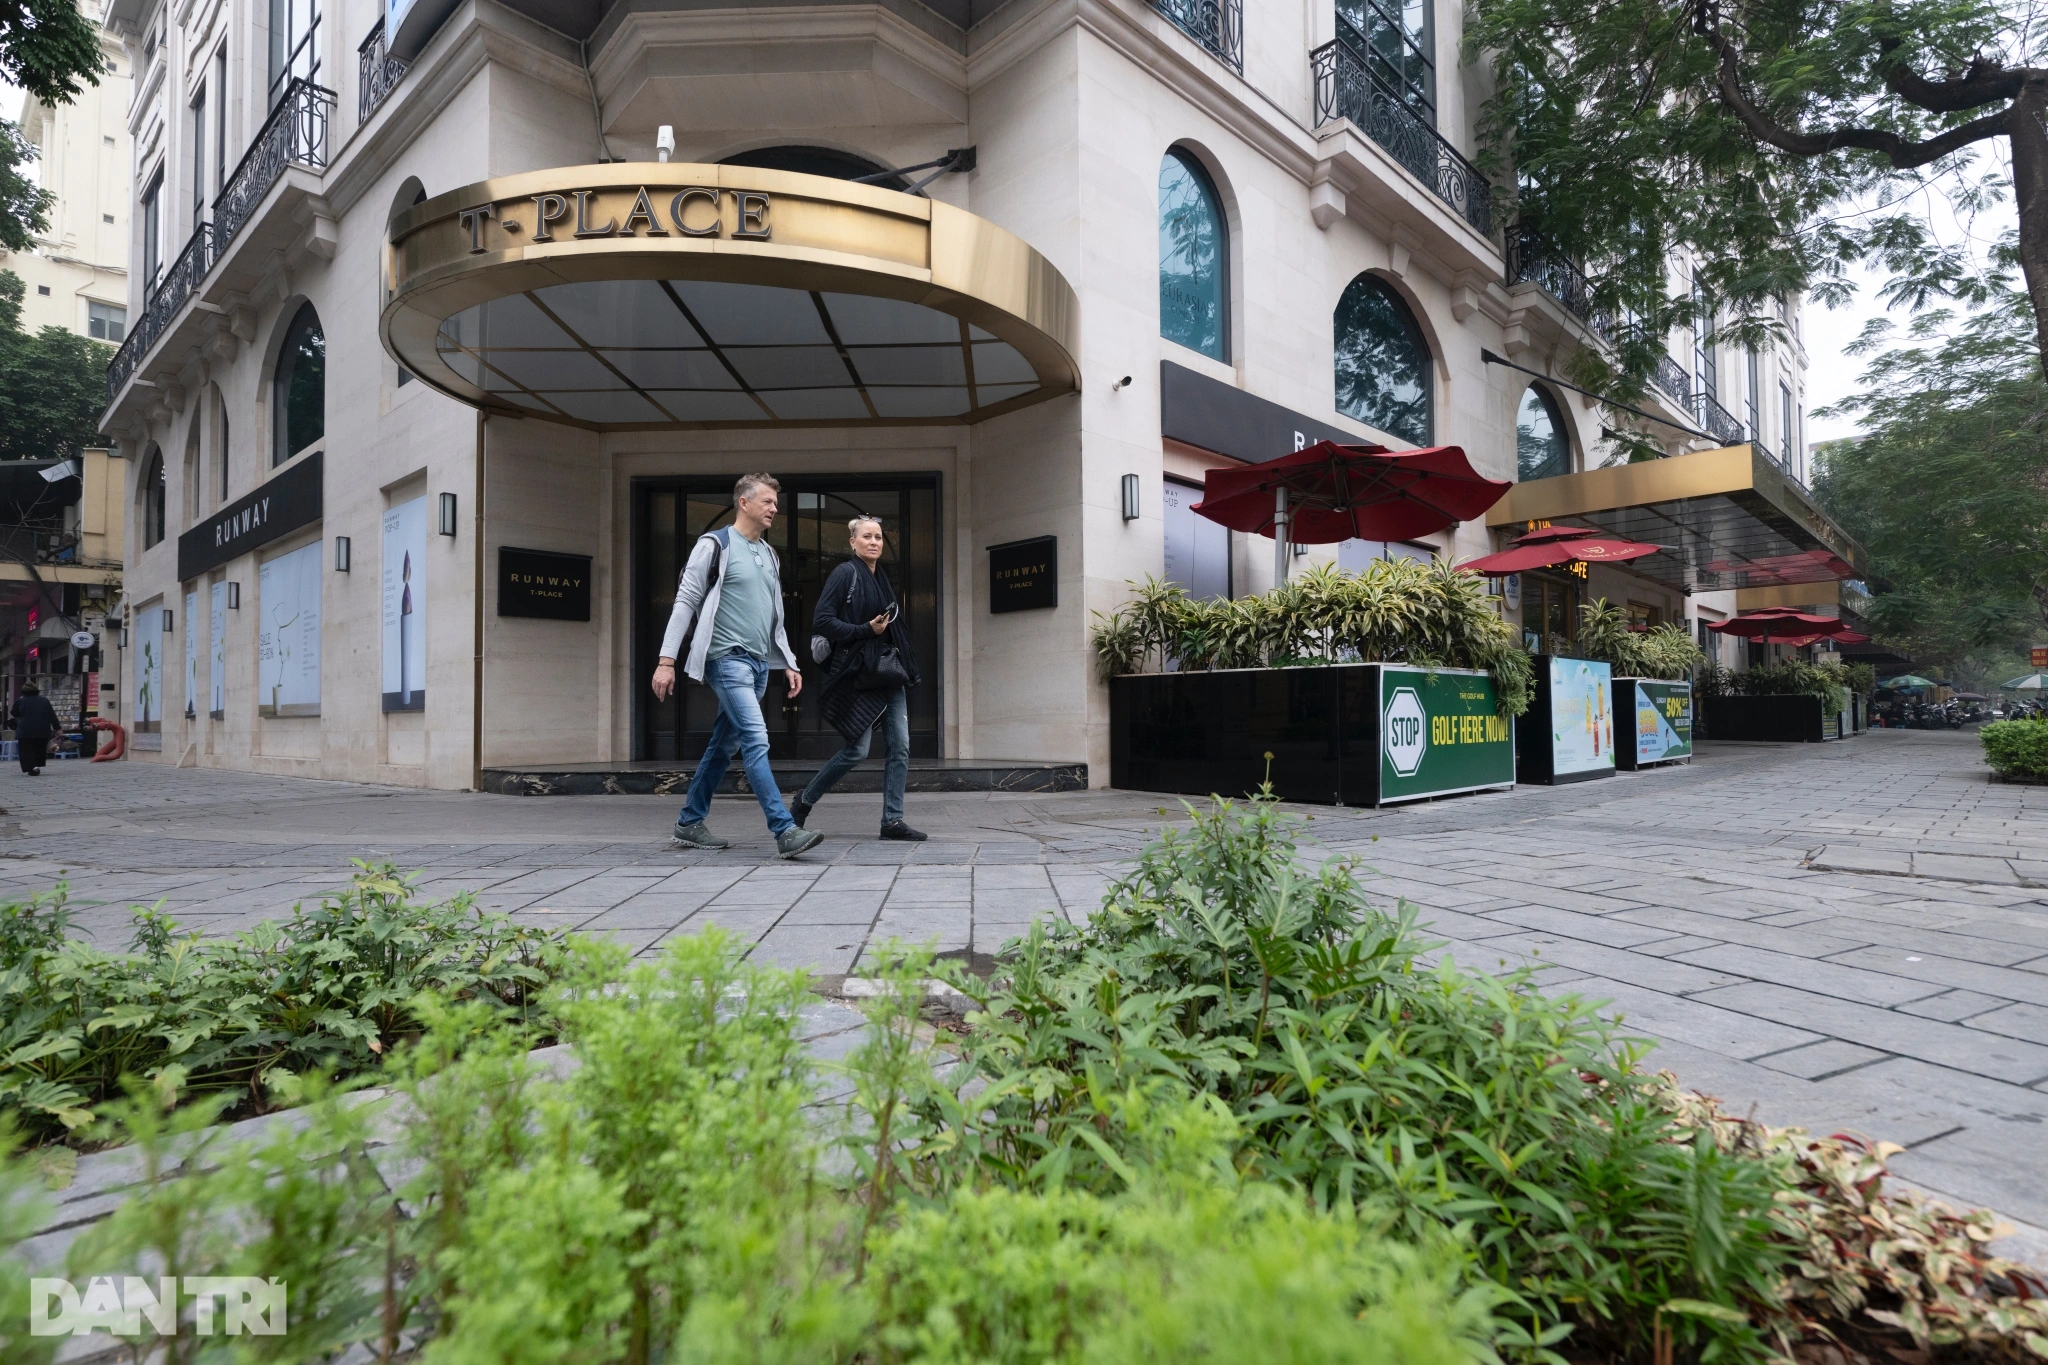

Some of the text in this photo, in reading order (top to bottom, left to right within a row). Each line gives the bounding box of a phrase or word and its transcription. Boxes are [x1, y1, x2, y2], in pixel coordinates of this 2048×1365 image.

[1294, 430, 1318, 453] R
[216, 496, 270, 547] RUNWAY
[510, 573, 581, 588] RUNWAY
[996, 563, 1046, 580] RUNWAY
[530, 589, 563, 598] T-PLACE
[1666, 697, 1682, 717] 50%
[1391, 717, 1419, 747] STOP
[1432, 715, 1508, 745] GOLF HERE NOW!
